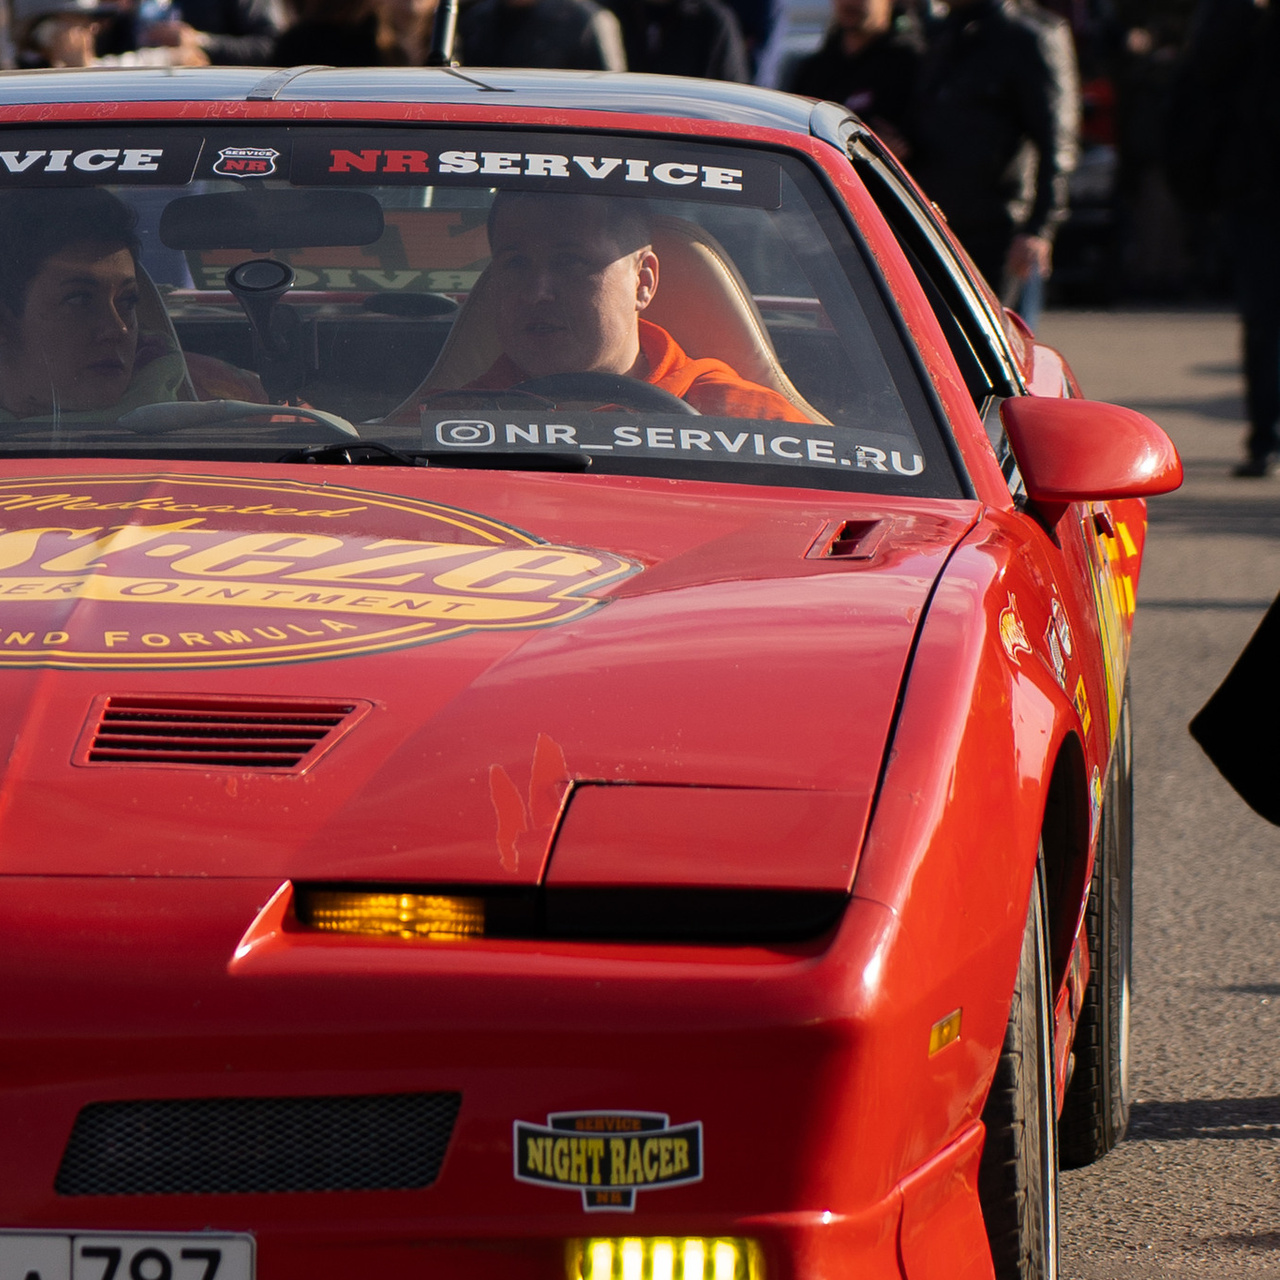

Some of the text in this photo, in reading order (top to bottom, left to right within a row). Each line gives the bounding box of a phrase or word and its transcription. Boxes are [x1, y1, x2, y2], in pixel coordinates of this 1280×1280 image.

[223, 159, 268, 172] NR
[119, 581, 476, 613] OINTMENT
[104, 618, 358, 648] FORMULA
[527, 1136, 690, 1186] NIGHT RACER
